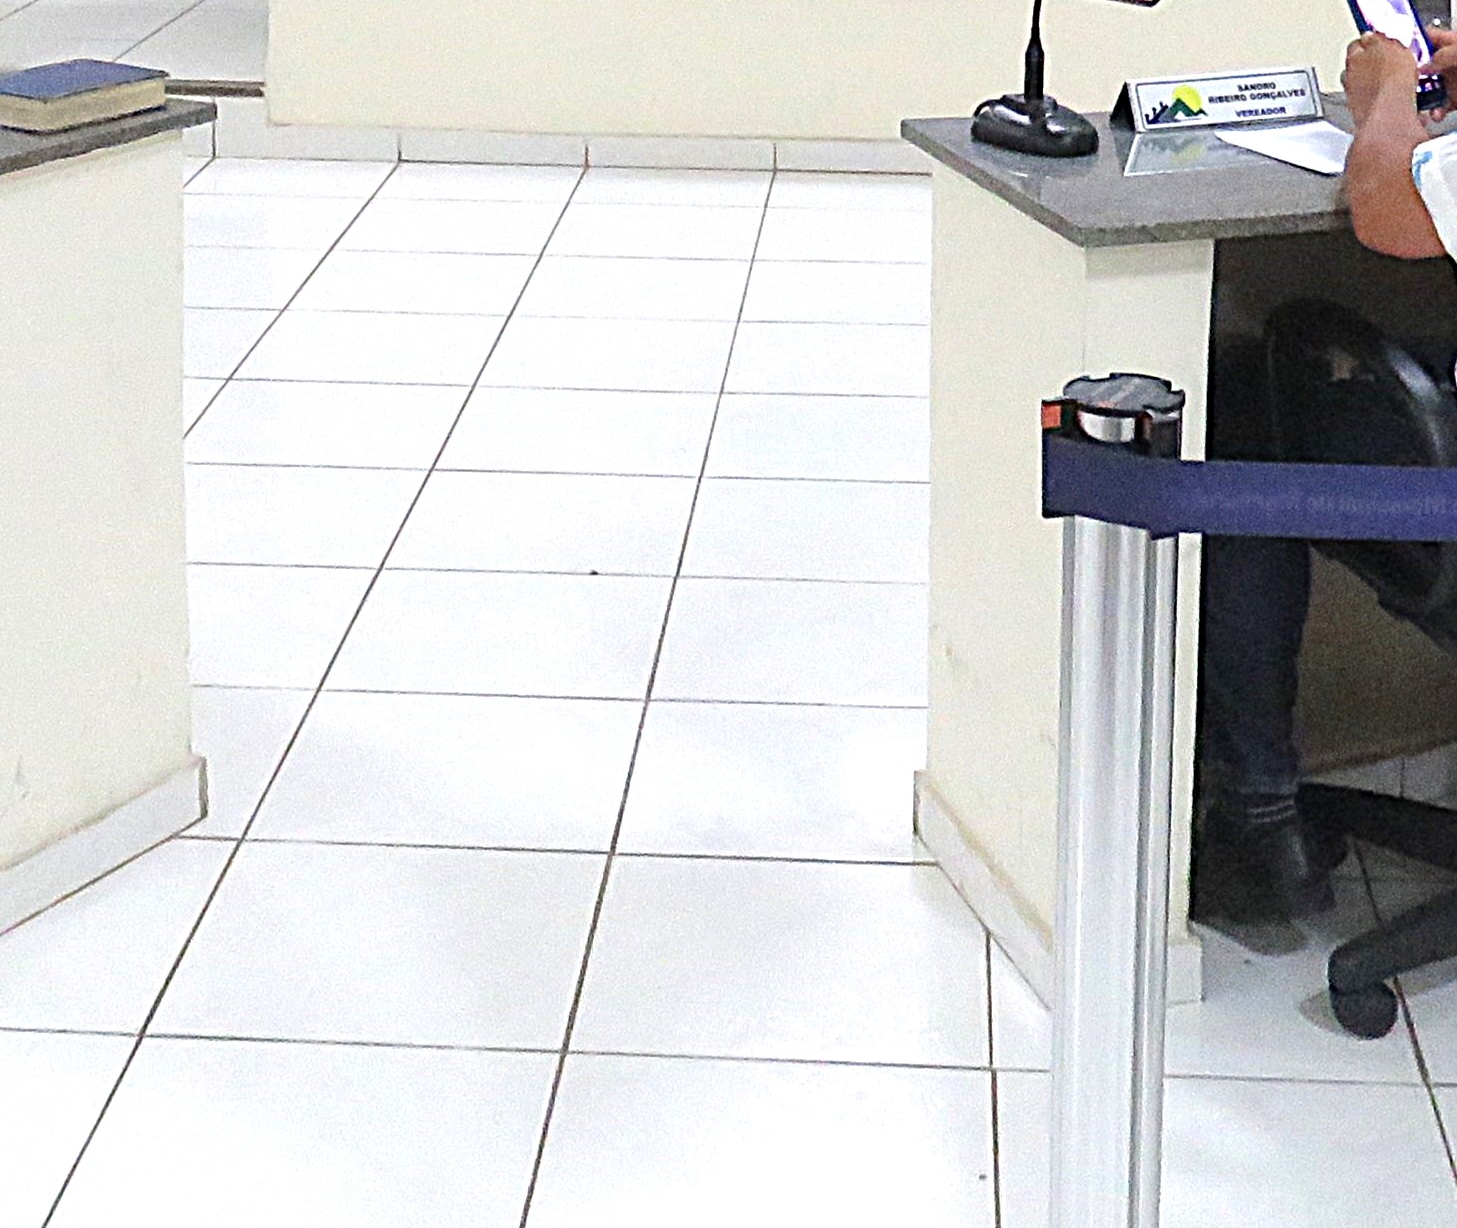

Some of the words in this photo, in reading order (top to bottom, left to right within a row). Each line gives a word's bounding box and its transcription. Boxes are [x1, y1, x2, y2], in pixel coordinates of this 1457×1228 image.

[1237, 82, 1276, 92] SANDRO
[1208, 94, 1247, 104] RIBEIRO
[1249, 88, 1306, 101] GONÇALVES
[1235, 106, 1287, 118] VEREADOR
